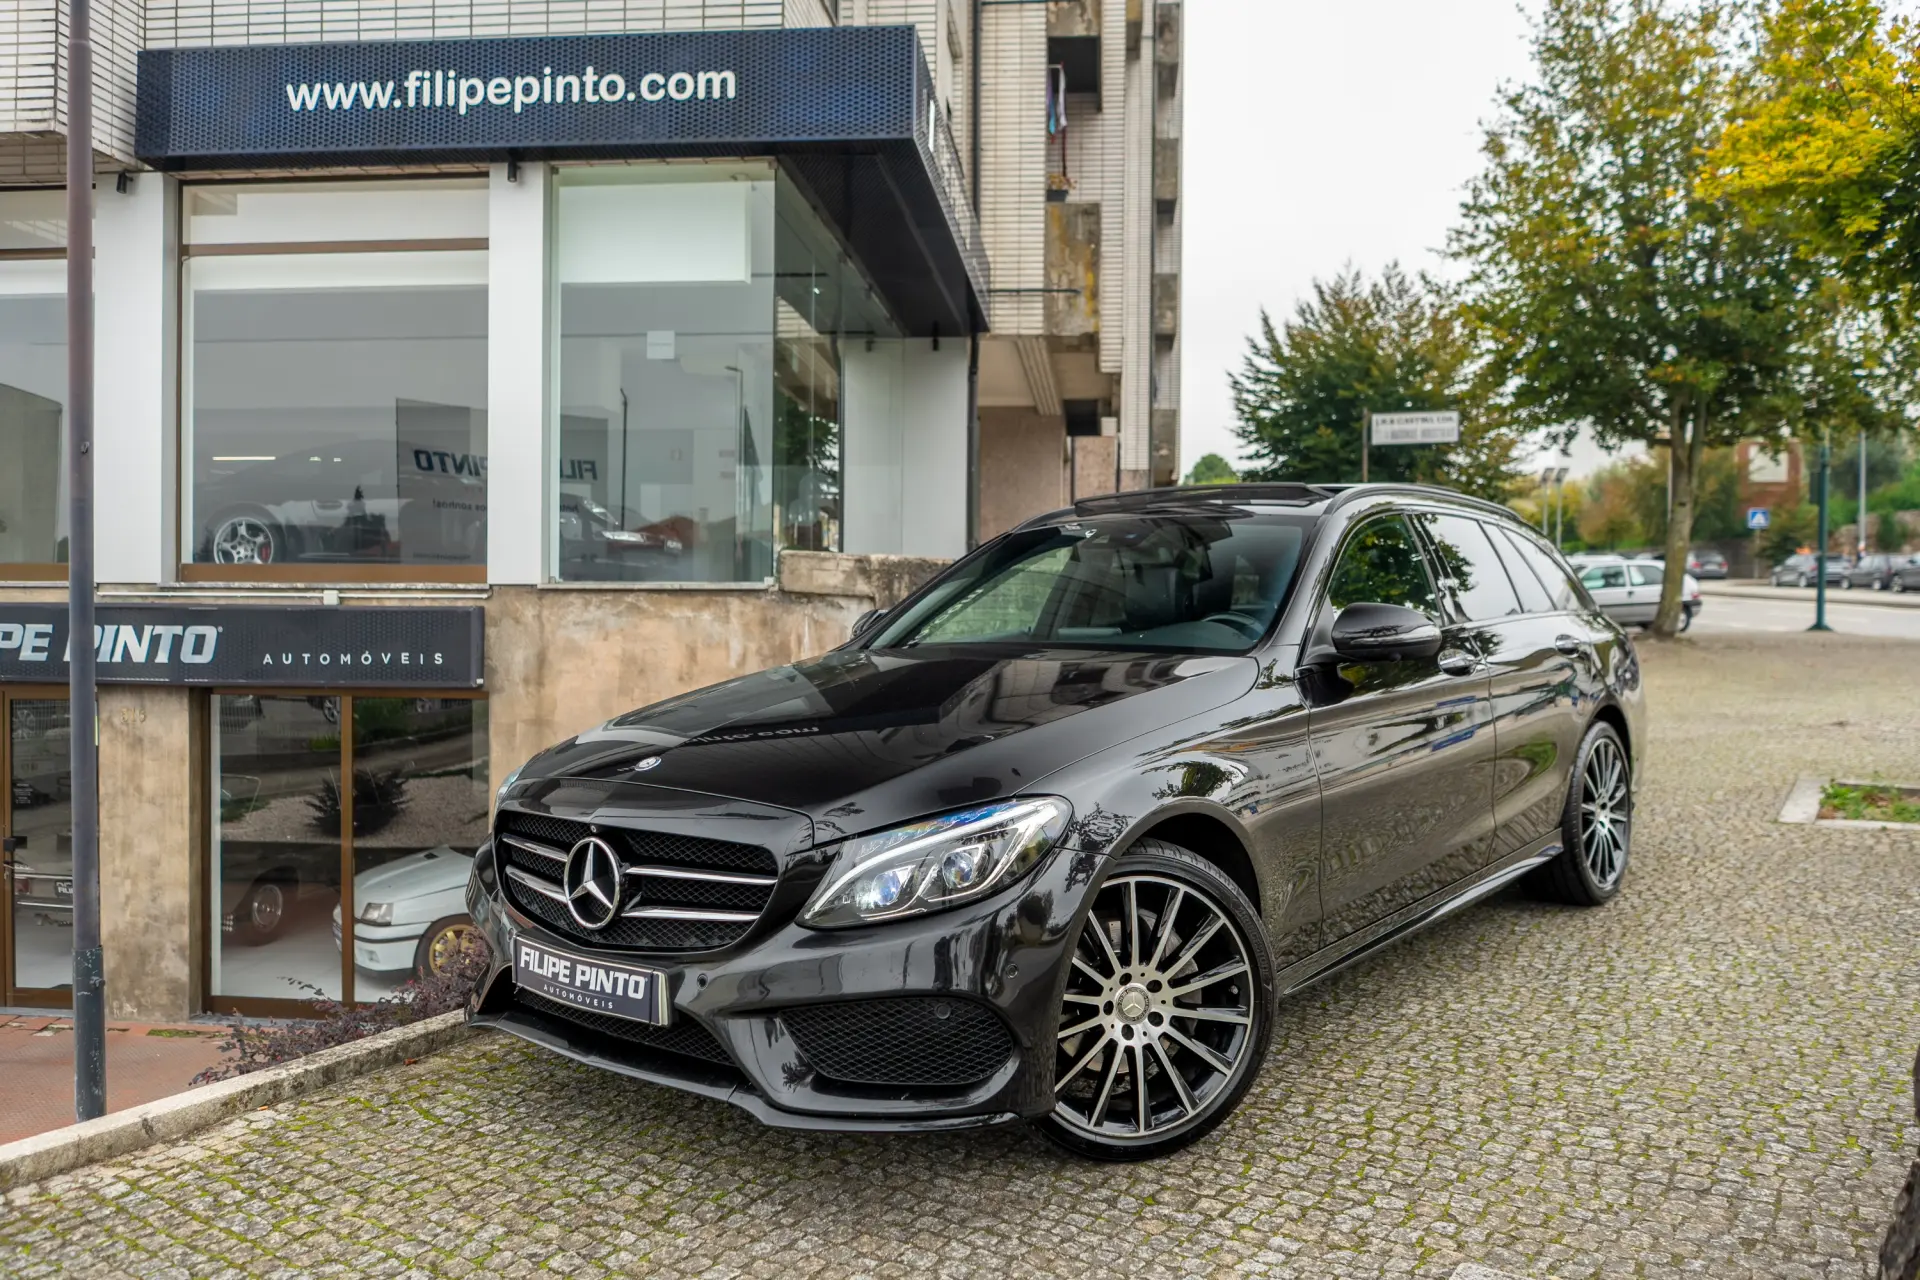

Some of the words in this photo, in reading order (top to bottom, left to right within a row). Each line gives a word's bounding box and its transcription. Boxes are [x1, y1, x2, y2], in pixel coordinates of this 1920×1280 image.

[286, 65, 736, 115] www.filipepinto.com
[262, 651, 443, 665] AUTOMÓVEIS
[519, 945, 571, 984] FILIPE
[574, 963, 646, 1000] PINTO
[543, 983, 613, 1009] AUTOMÓVEIS
